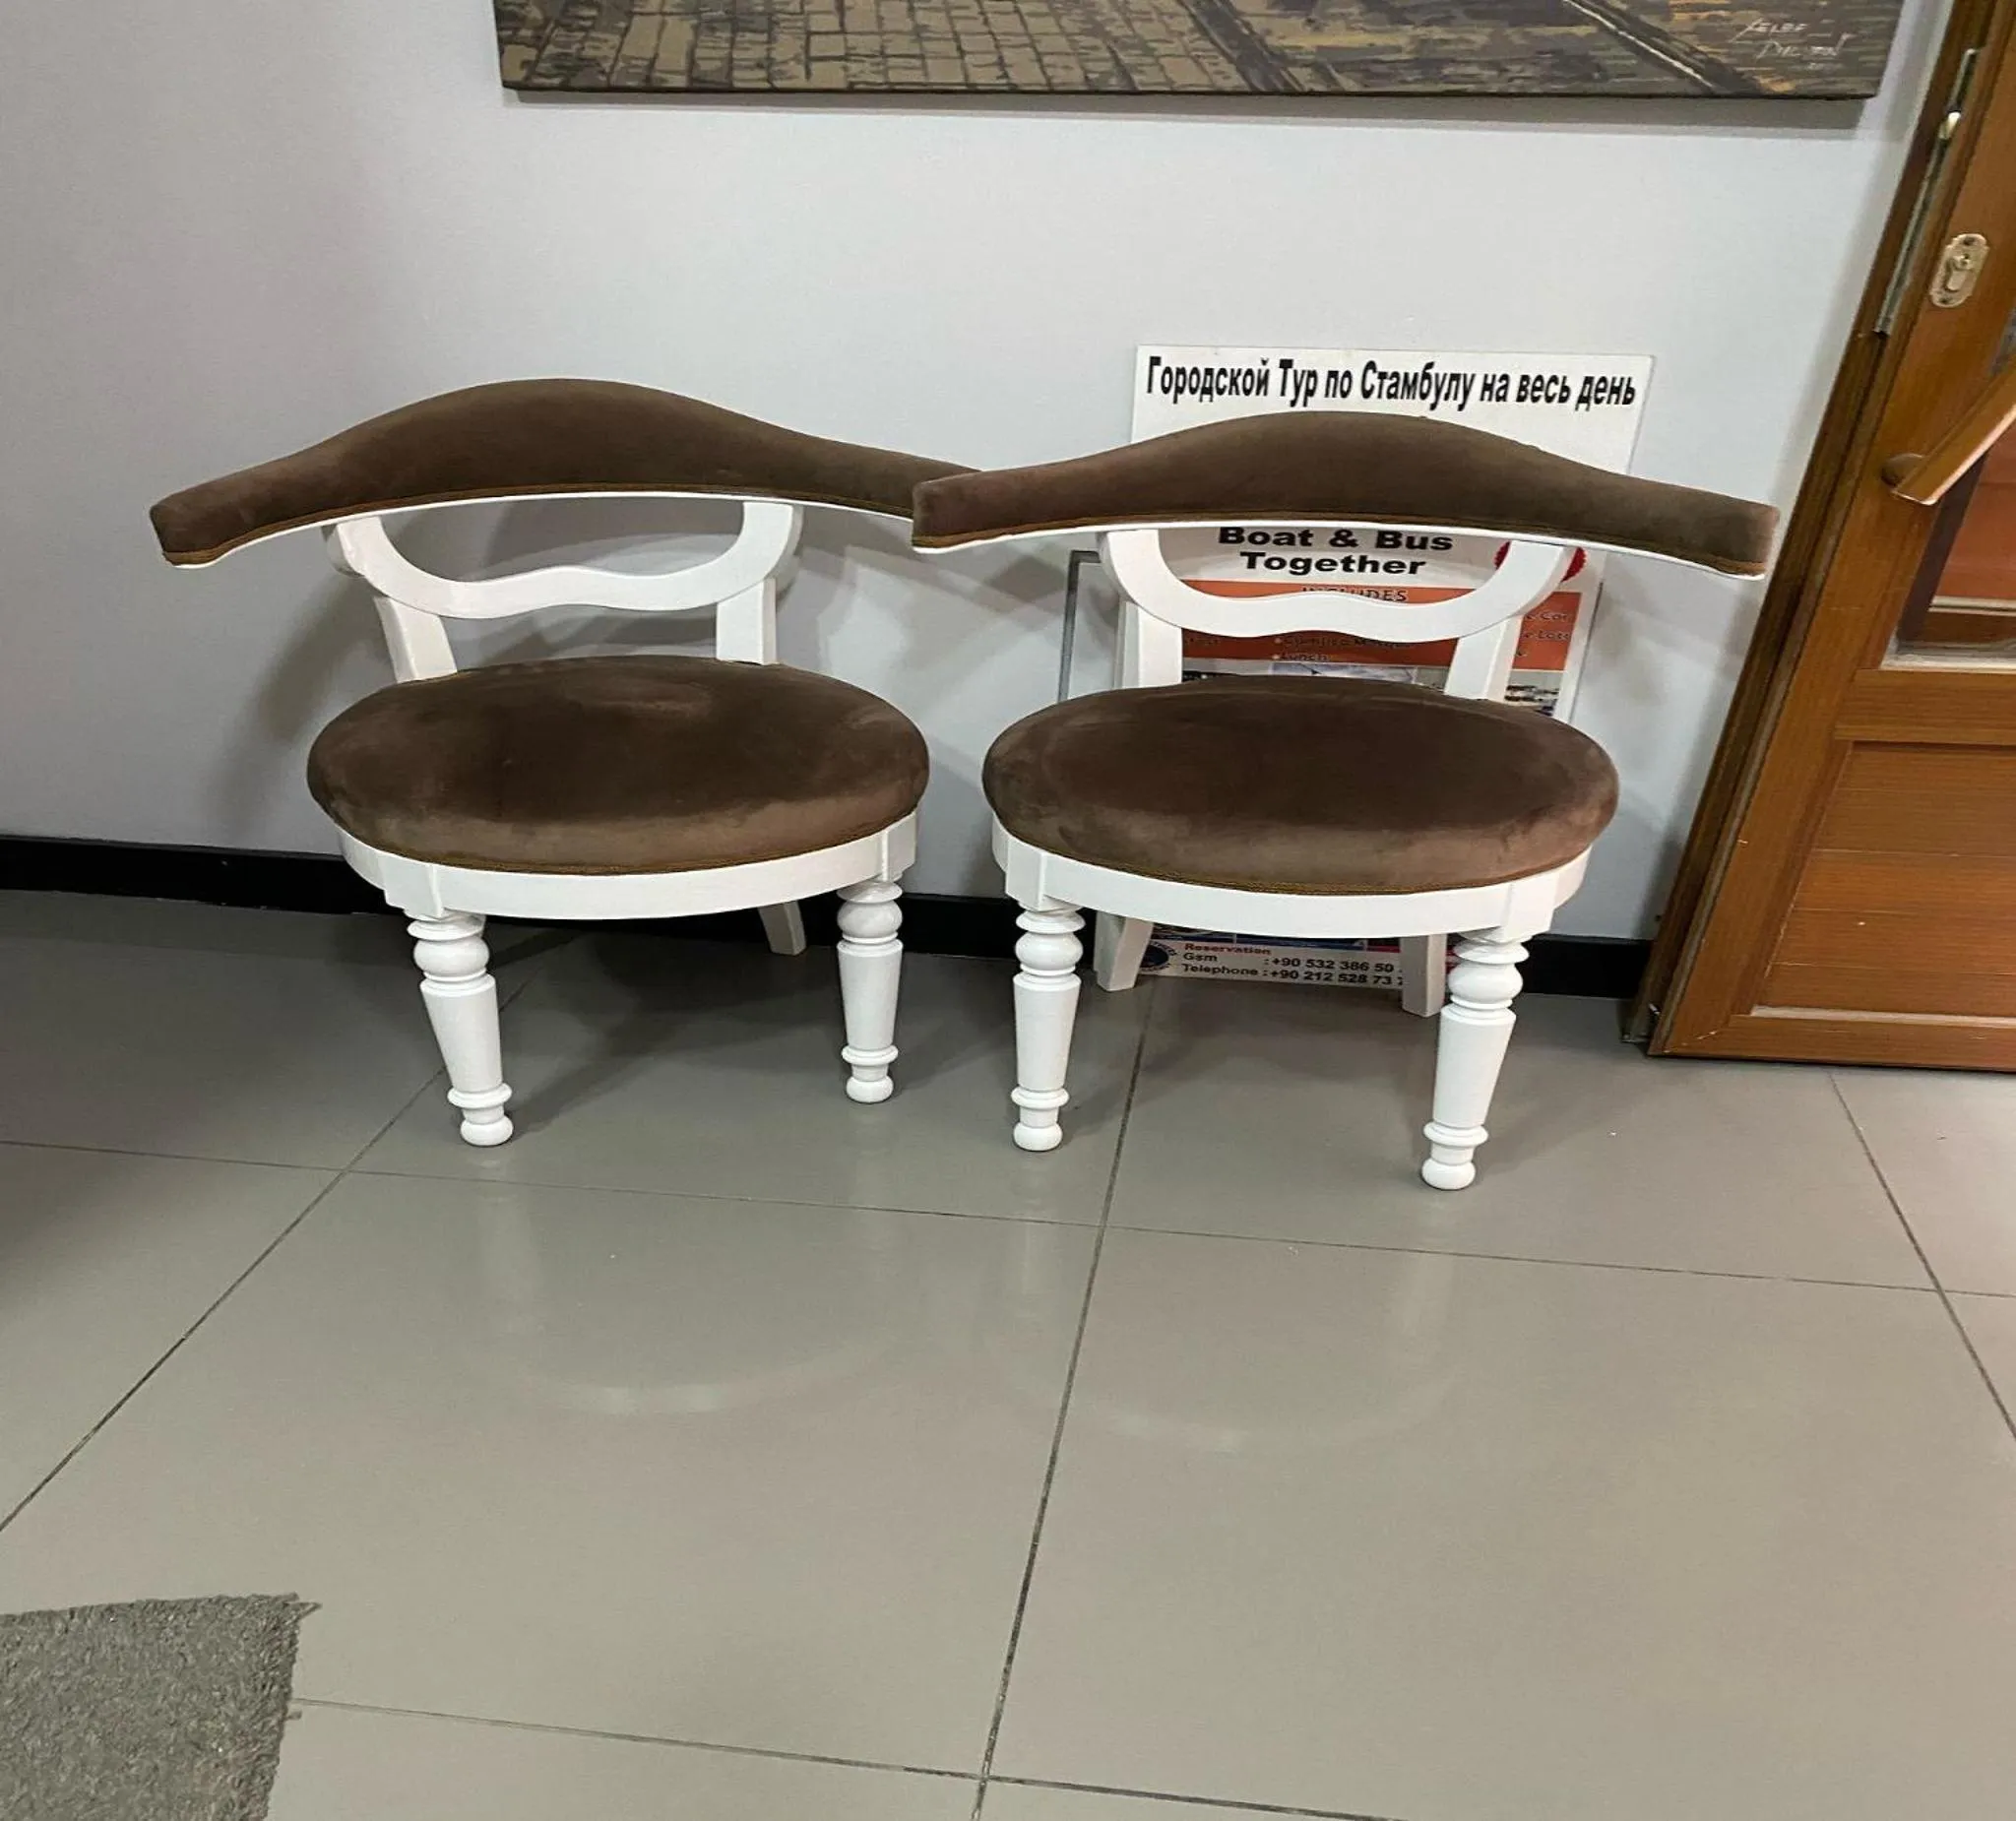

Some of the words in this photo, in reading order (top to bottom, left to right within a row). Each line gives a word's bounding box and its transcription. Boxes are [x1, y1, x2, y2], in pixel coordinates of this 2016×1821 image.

[1147, 356, 1271, 405] Городской
[1279, 358, 1318, 408] Тур
[1324, 370, 1353, 399] по
[1360, 360, 1476, 411] Стамбулу
[1480, 373, 1511, 403] на
[1516, 374, 1571, 404] весь
[1575, 375, 1635, 411] день
[1219, 527, 1314, 547] Boat
[1329, 529, 1358, 548] &
[1375, 530, 1453, 550] Bus
[1239, 551, 1426, 576] Together
[1184, 943, 1272, 955] Reservation
[1183, 952, 1218, 962] Gsm
[1305, 959, 1335, 969] 532
[1183, 964, 1258, 975] Telephone
[1304, 971, 1334, 981] 212
[1373, 974, 1393, 984] 73
